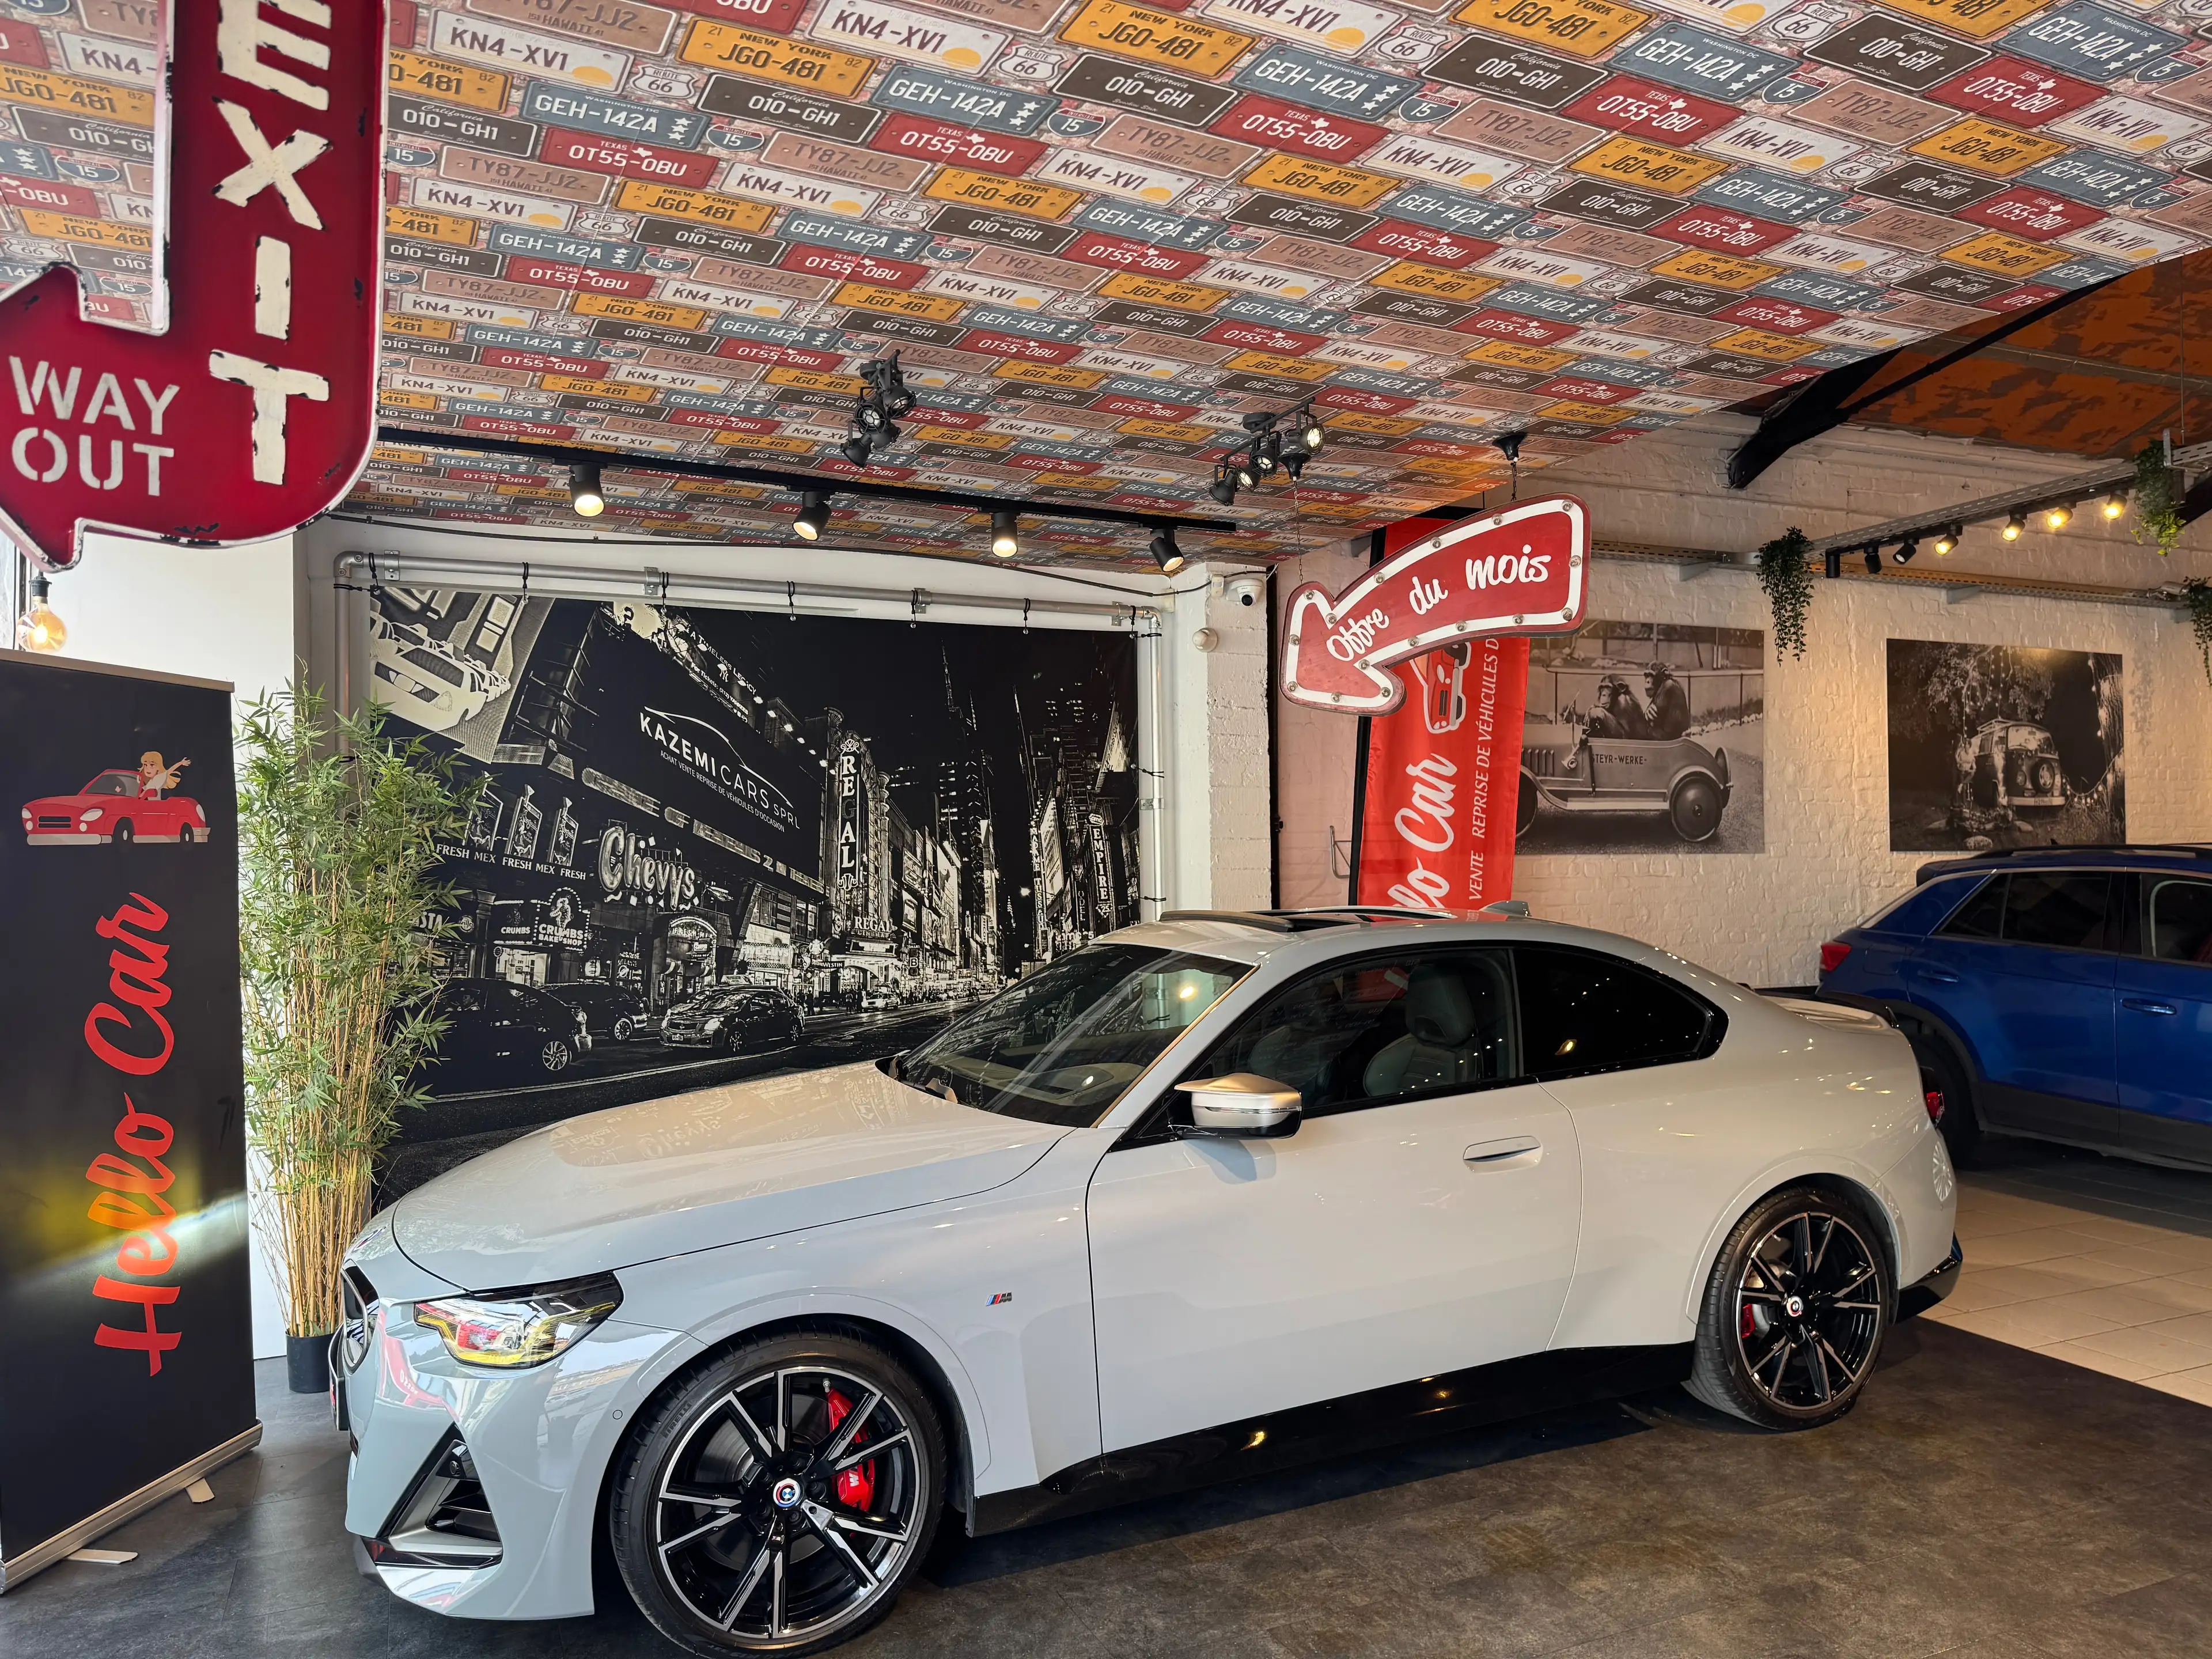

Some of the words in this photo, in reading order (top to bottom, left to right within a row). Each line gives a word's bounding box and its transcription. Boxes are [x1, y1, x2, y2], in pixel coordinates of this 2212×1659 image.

[1100, 3, 1116, 13] 21
[1129, 10, 1168, 24] NEW
[1175, 21, 1215, 37] YORK
[1224, 36, 1242, 46] 82
[1410, 29, 1438, 41] ROUTE
[740, 34, 779, 47] NEW
[789, 44, 832, 58] YORK
[844, 57, 861, 66] 82
[1024, 50, 1052, 61] ROUTE
[1391, 41, 1420, 56] 66
[1013, 61, 1039, 74] 66
[1635, 36, 1744, 82] GEH-142A
[653, 69, 681, 79] ROUTE
[1255, 58, 1368, 101] GEH-142A
[2019, 70, 2044, 82] TEXAS
[57, 77, 111, 93] YORK
[127, 92, 145, 101] 82
[648, 80, 672, 92] 66
[1646, 90, 1671, 101] TEXAS
[1772, 83, 1804, 98] 15
[888, 78, 1006, 119] GEH-142A
[533, 94, 657, 133] GEH-142A
[1285, 110, 1310, 120] TEXAS
[1410, 103, 1437, 116] 15
[937, 126, 963, 136] TEXAS
[1060, 118, 1084, 131] 15
[1832, 118, 1872, 132] HAWAII
[1983, 128, 2013, 138] NEW
[1483, 135, 1522, 149] HAWAII
[1637, 147, 1667, 156] NEW
[1862, 157, 1886, 165] ROUTE
[75, 165, 99, 178] 15
[1839, 166, 1866, 176] 66
[1016, 183, 1050, 193] YORK
[2140, 192, 2170, 203] 15
[704, 196, 740, 206] YORK
[1396, 195, 1489, 224] GEH-142A
[1088, 207, 1184, 237] GEH-142A
[1826, 210, 1853, 219] 15
[210, 0, 331, 485] EXIT
[789, 219, 889, 248] GEH-142A
[498, 232, 601, 260] GEH-142A
[1497, 290, 1575, 312] GEH-142A
[9, 355, 180, 435] WAY
[1111, 381, 1181, 397] GEH-142A
[12, 427, 174, 496] OUT
[1408, 576, 1448, 616] du
[1465, 544, 1552, 590] mois
[1475, 655, 1498, 742] VÉHICULES
[1482, 744, 1491, 768] DE
[640, 712, 716, 777] KAZEMI
[721, 765, 769, 809] CARS
[774, 804, 800, 830] SPRL
[660, 750, 677, 766] ACHAT
[678, 760, 695, 777] VENTE
[696, 771, 718, 791] REPRISE
[718, 786, 726, 797] DE
[726, 791, 754, 813] VÉHICULES
[840, 755, 857, 869] REGAL
[1395, 753, 1457, 852] Car
[1472, 770, 1488, 839] REPRISE
[436, 844, 469, 859] FRESH
[474, 851, 496, 863] MEX
[502, 857, 532, 870] FRESH
[536, 863, 555, 874] MEX
[560, 869, 586, 880] FRESH
[599, 826, 695, 910] Chevys
[1093, 828, 1109, 900] EMPIRE
[1469, 850, 1484, 900] VENTE
[501, 926, 531, 935] CRUMBS
[539, 923, 584, 940] CRUMBS
[854, 916, 892, 933] REGAL
[563, 938, 582, 947] SHOP
[85, 892, 175, 1075] Car
[86, 1092, 182, 1376] Hello
